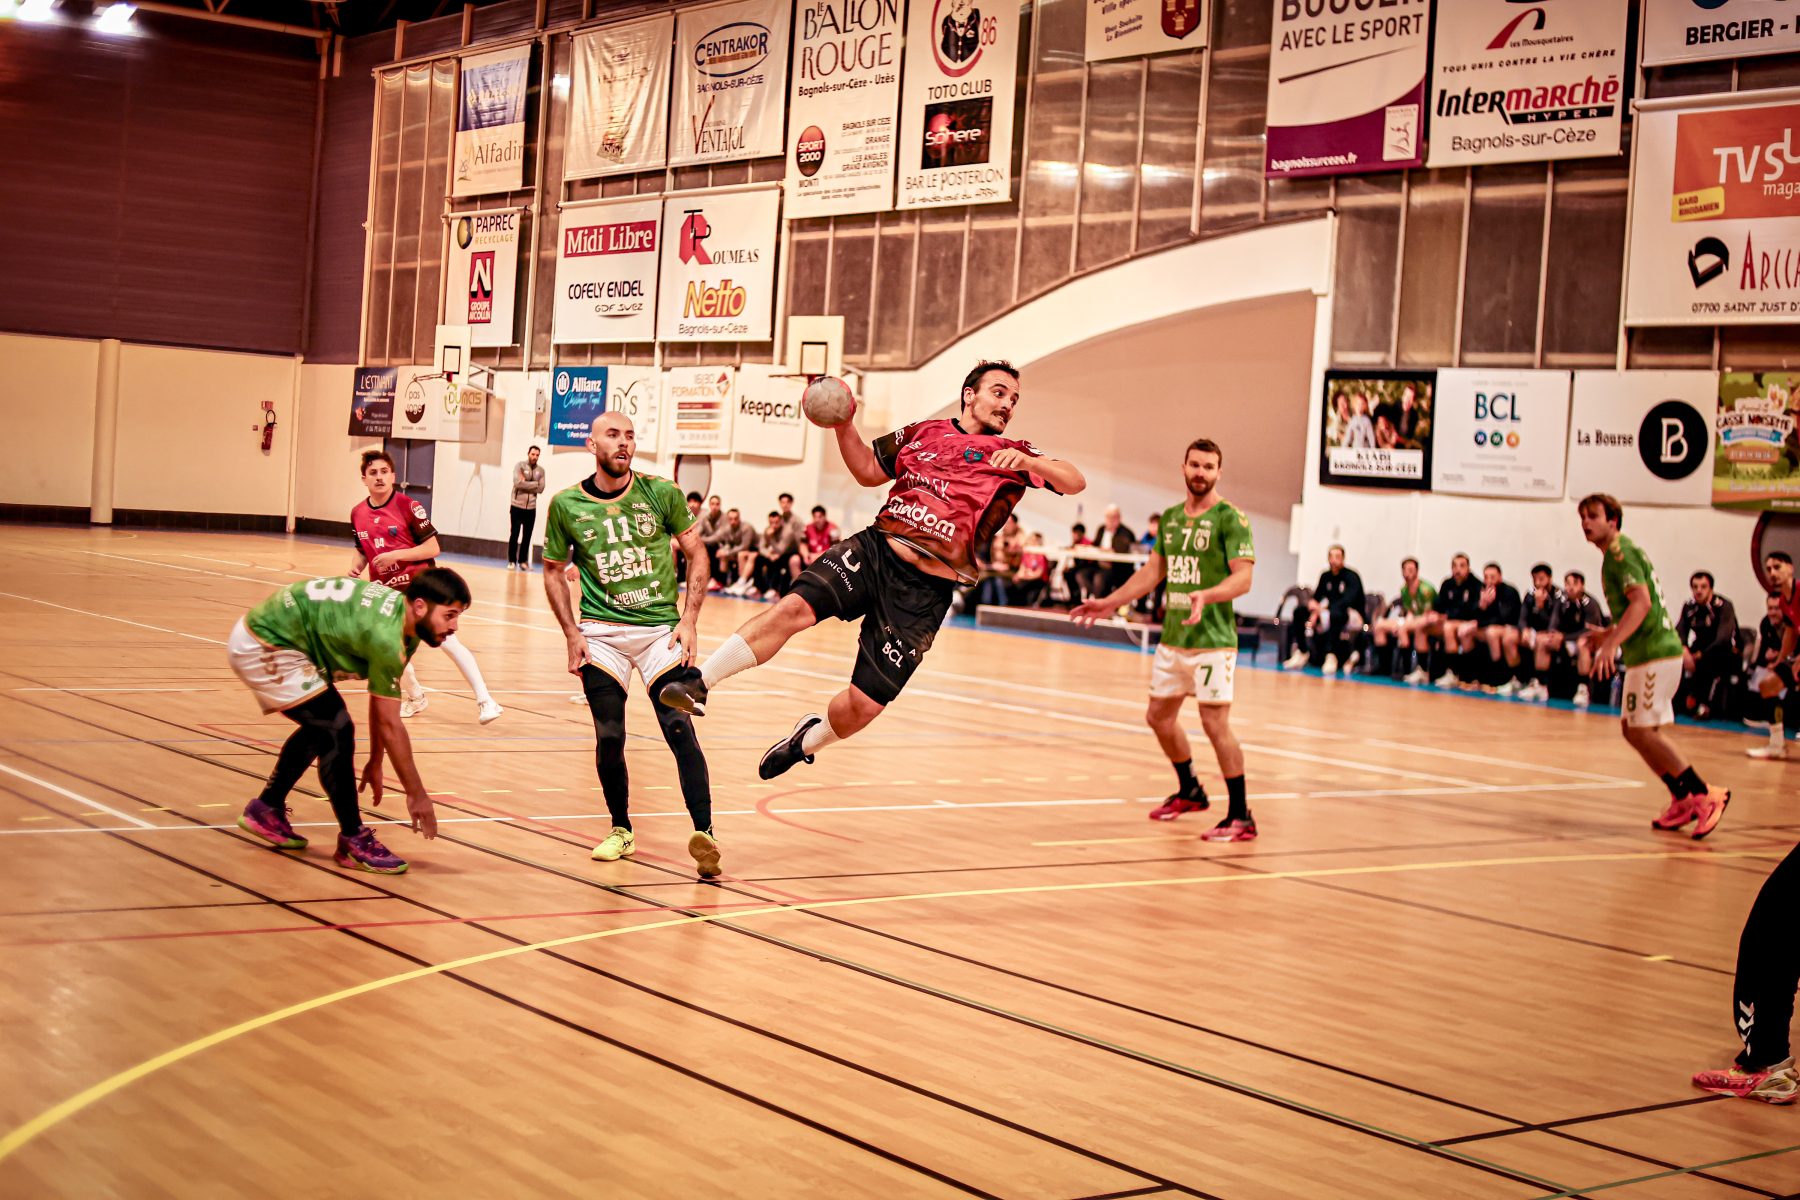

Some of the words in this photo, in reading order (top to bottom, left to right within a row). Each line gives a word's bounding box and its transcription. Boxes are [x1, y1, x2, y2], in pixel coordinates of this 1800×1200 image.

[804, 0, 897, 40] BALLON
[981, 16, 998, 46] 86
[1280, 26, 1327, 51] AVEC
[1332, 23, 1355, 44] LE
[1360, 13, 1424, 40] SPORT
[1685, 18, 1774, 46] BERGIER
[694, 32, 769, 66] CENTRAKOR
[801, 32, 893, 80] ROUGE
[1471, 61, 1493, 71] UNIS
[1498, 57, 1538, 68] CONTRE
[1542, 54, 1555, 63] LA
[1560, 53, 1577, 62] VIE
[928, 83, 958, 100] TOTO
[961, 79, 992, 96] CLUB
[1437, 74, 1620, 125] Intermarché
[1526, 109, 1599, 123] HYPER
[798, 139, 825, 152] SPORT
[1451, 127, 1597, 153] Bagnols-sur-Cèze
[800, 151, 822, 163] 2000
[475, 214, 515, 233] PAPREC
[475, 234, 514, 245] RECYCLAGE
[567, 228, 603, 254] Midi
[608, 225, 653, 251] Libre
[568, 282, 605, 300] COFELY
[607, 280, 645, 298] ENDEL
[683, 279, 746, 318] Netto
[470, 301, 491, 311] GROUPE
[595, 304, 615, 313] GDF
[1723, 302, 1757, 313] SAINT
[1760, 302, 1787, 313] JUST
[571, 377, 602, 392] Allianz
[1474, 392, 1521, 421] BCL
[1577, 429, 1591, 446] La
[1595, 429, 1634, 447] Bourse
[602, 516, 633, 544] 11
[1181, 528, 1193, 551] 7
[595, 546, 647, 569] EASY
[1167, 555, 1200, 570] EASY
[822, 558, 854, 592] UNICOMM
[881, 641, 904, 668] BCL
[1200, 665, 1213, 686] 7
[1626, 692, 1637, 713] 8
